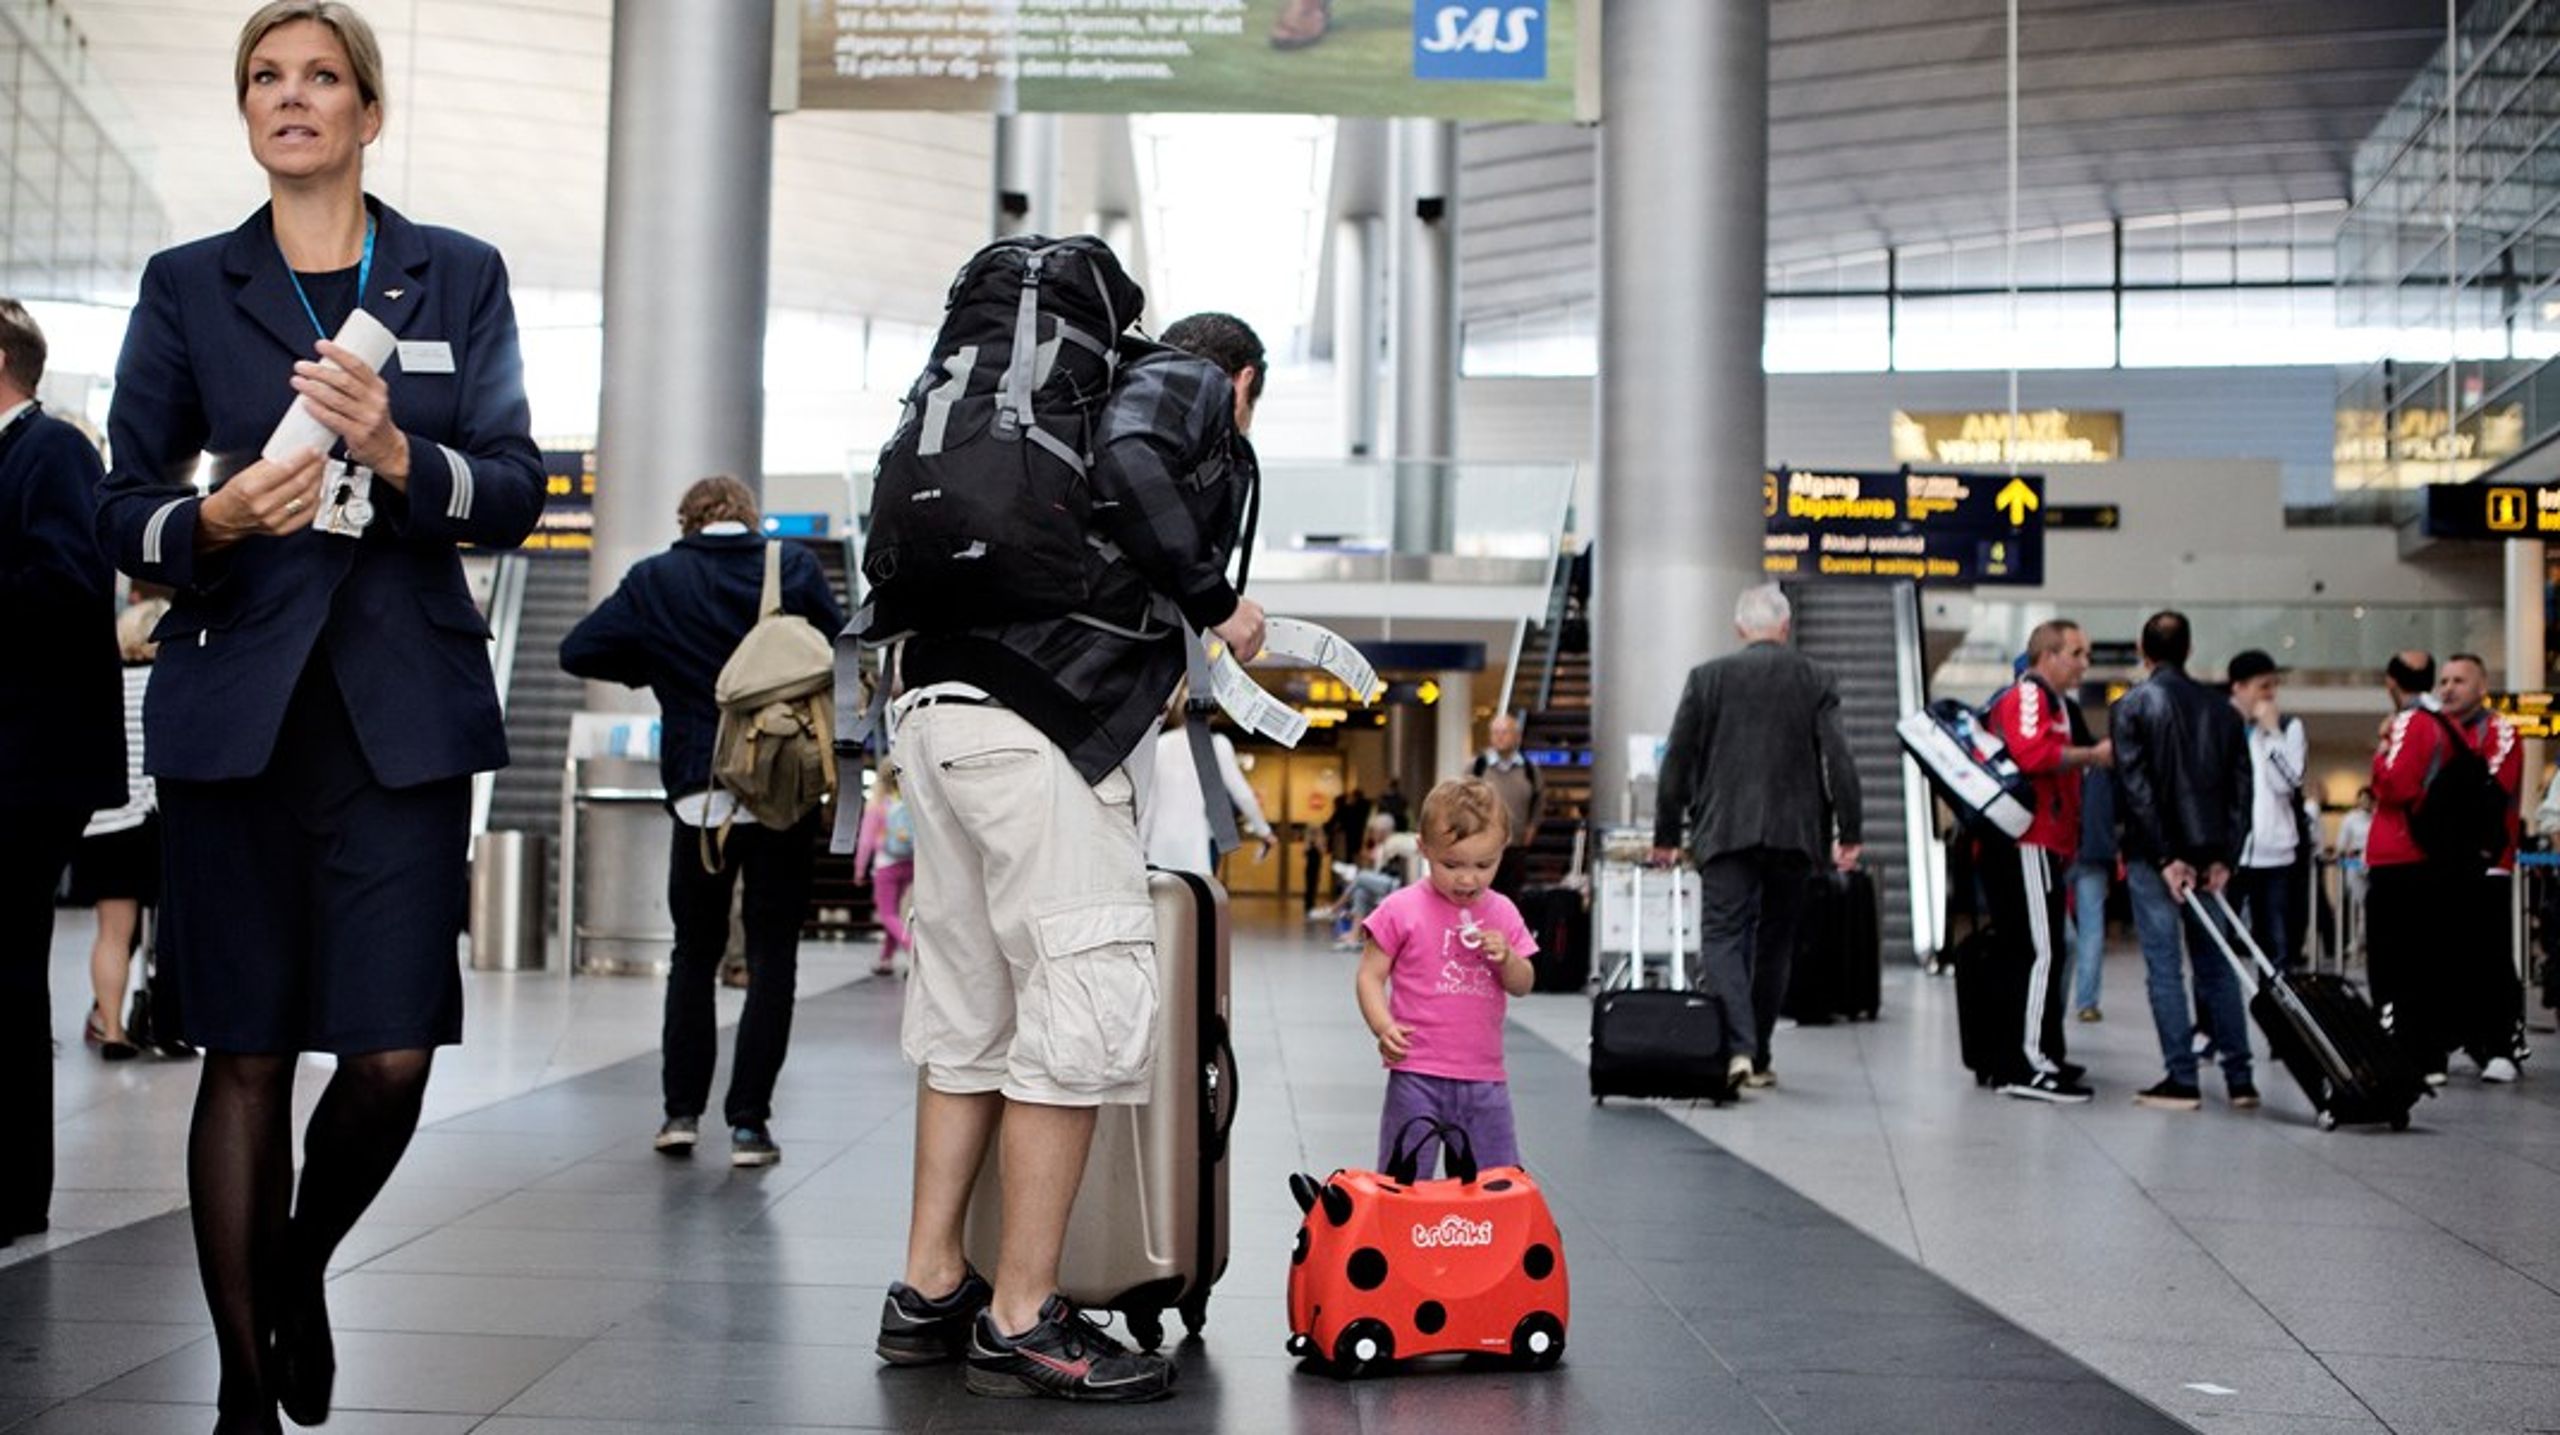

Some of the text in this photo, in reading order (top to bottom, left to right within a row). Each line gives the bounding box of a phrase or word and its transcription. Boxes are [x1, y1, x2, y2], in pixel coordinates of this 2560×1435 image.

[863, 11, 888, 29] du
[1064, 14, 1144, 35] hjemme,
[1147, 14, 1179, 32] har
[1182, 15, 1200, 32] vi
[1201, 14, 1243, 33] flest
[1419, 6, 1540, 53] SAS
[911, 35, 930, 53] at
[932, 35, 985, 56] vælge
[1068, 35, 1192, 56] Skandinavien.
[860, 57, 916, 80] glæde
[919, 56, 946, 76] for
[948, 57, 979, 80] dig
[1023, 58, 1063, 77] dem
[1065, 58, 1174, 81] derhjemme.
[1789, 472, 1860, 502] Afgang
[1788, 494, 1896, 521] Departures
[1820, 533, 1926, 554] Aktuel ventetid
[1819, 554, 1960, 579] Current waiting time
[1411, 1214, 1493, 1248] trunki
